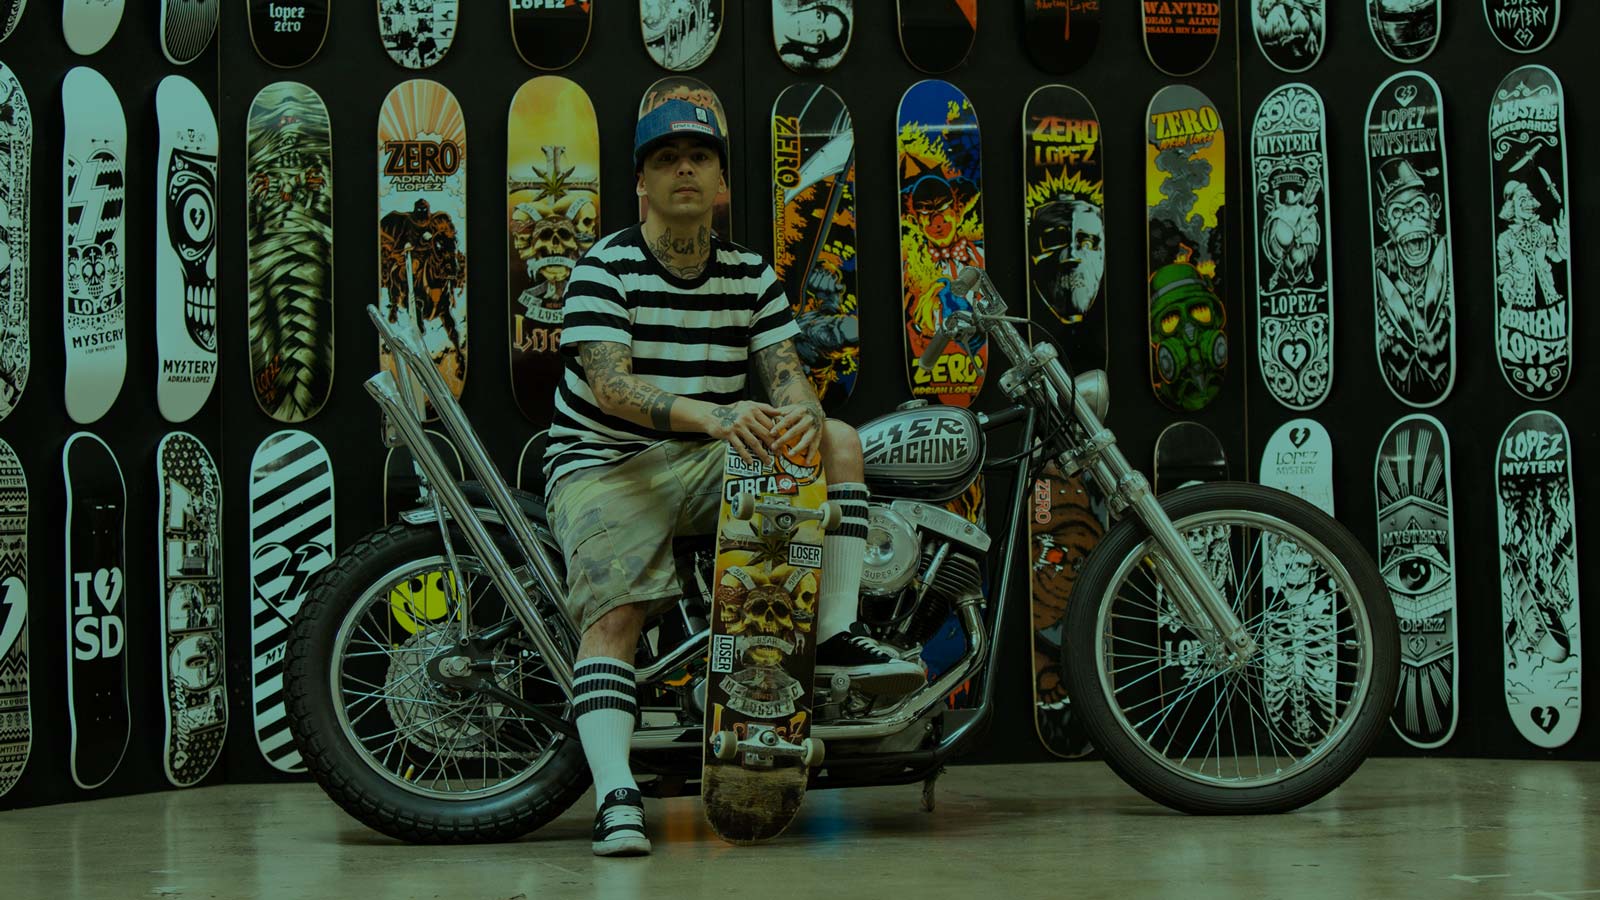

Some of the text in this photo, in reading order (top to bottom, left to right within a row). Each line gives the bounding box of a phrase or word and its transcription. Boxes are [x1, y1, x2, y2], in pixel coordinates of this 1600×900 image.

[269, 3, 305, 22] lopez
[1144, 1, 1219, 15] WANTED
[1494, 6, 1548, 29] MYSTERY
[274, 21, 301, 32] zero
[1145, 16, 1172, 24] DEAD
[1188, 17, 1219, 25] ALIVE
[1032, 116, 1099, 144] ZERO
[1151, 106, 1219, 139] ZERO
[1381, 106, 1426, 132] LOPEZ
[1256, 132, 1319, 155] MYSTERY
[1370, 128, 1438, 157] MYSTERY
[384, 140, 460, 176] ZERO
[1034, 145, 1096, 166] LOPEZ
[391, 176, 446, 184] ADRIAN
[397, 184, 443, 192] LOPEZ
[774, 114, 801, 259] ZERO ADRIAN LOPEZ
[74, 291, 119, 315] LOPEZ
[1270, 294, 1317, 315] LOPEZ
[1499, 301, 1567, 340] ADRIAN
[73, 329, 123, 348] MYSTERY
[1500, 327, 1567, 365] LOPEZ
[164, 359, 217, 374] MYSTERY
[913, 354, 983, 384] ZERO
[914, 386, 978, 395] ADRIAN LOPEZ
[866, 438, 968, 464] MACHINE
[1505, 430, 1564, 461] LOPEZ
[728, 457, 760, 473] LOSER
[1276, 452, 1318, 464] LOPEZ
[1502, 460, 1565, 476] MYSTERY
[1276, 466, 1316, 475] MYSTERY
[1035, 478, 1051, 524] ZERO
[1382, 529, 1448, 547] MYSTERY
[791, 545, 820, 562] LOSER
[74, 572, 92, 615] I
[1400, 617, 1446, 633] OPEZ
[75, 616, 124, 660] SD
[719, 637, 733, 671] LOSER
[1164, 640, 1205, 666] LOP
